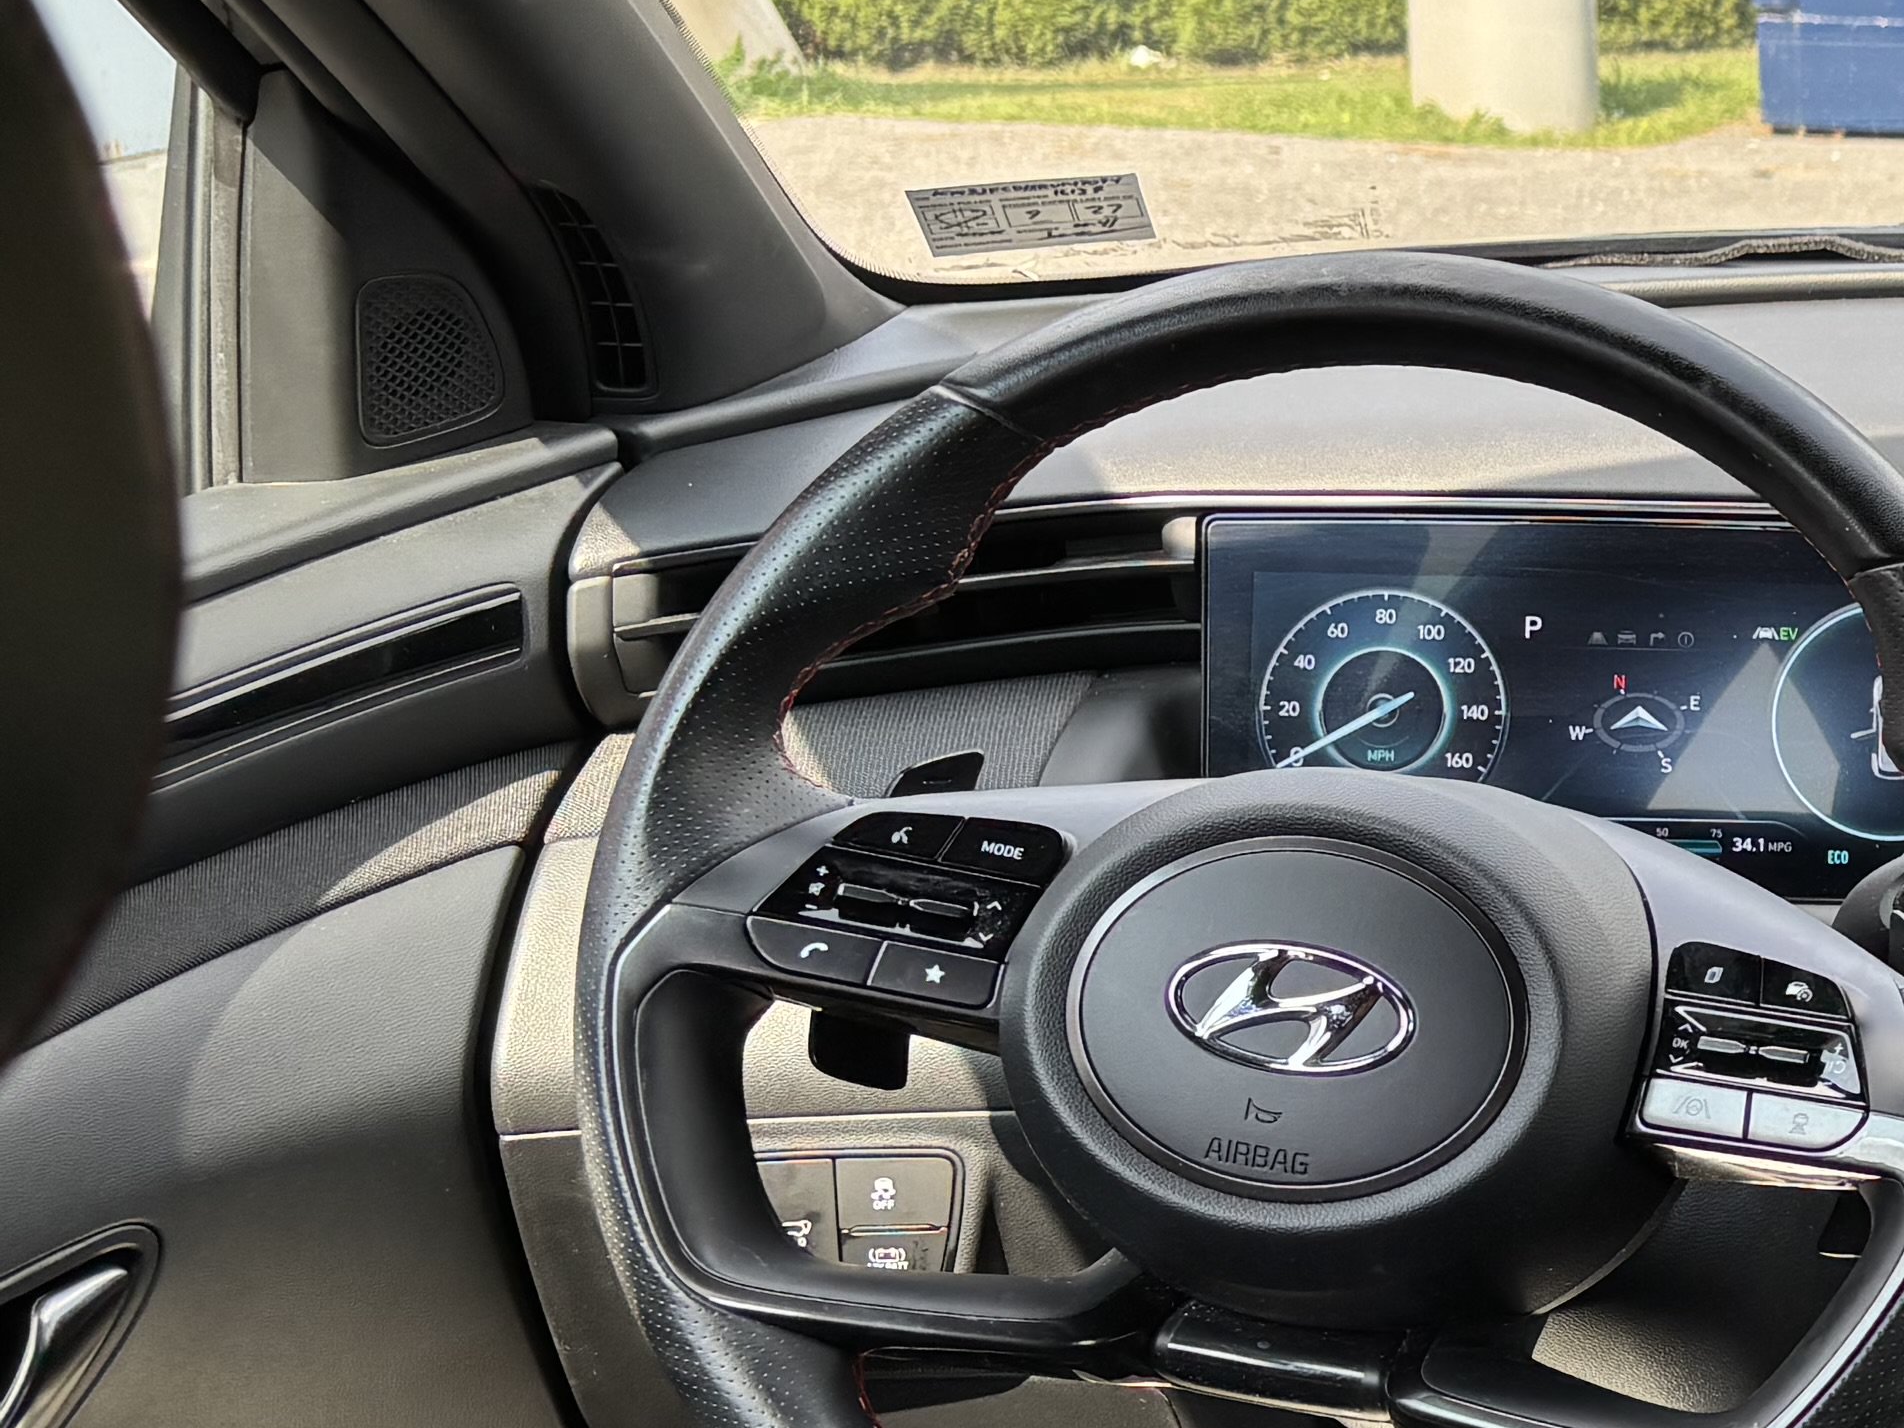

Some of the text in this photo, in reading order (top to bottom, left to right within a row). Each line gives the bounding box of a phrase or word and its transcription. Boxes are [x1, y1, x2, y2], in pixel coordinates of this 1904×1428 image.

[1375, 609, 1397, 625] 80
[1327, 622, 1445, 641] 60 100
[1524, 615, 1543, 640] P
[1779, 627, 1799, 642] EV
[1293, 653, 1475, 674] 40 120
[1613, 674, 1627, 689] N
[1279, 700, 1489, 721] 20 140
[1689, 696, 1701, 711] E
[1568, 725, 1586, 741] W
[1366, 749, 1395, 762] MPH
[1444, 751, 1473, 769] 160
[1660, 758, 1673, 773] S
[1655, 828, 1723, 838] 50 75
[980, 839, 1025, 861] MODE
[1731, 836, 1793, 853] 34.1 MPG
[1827, 849, 1849, 865] ECO
[1672, 1037, 1690, 1050] OK
[1204, 1136, 1310, 1176] AIRBAG
[873, 1199, 896, 1211] OFF
